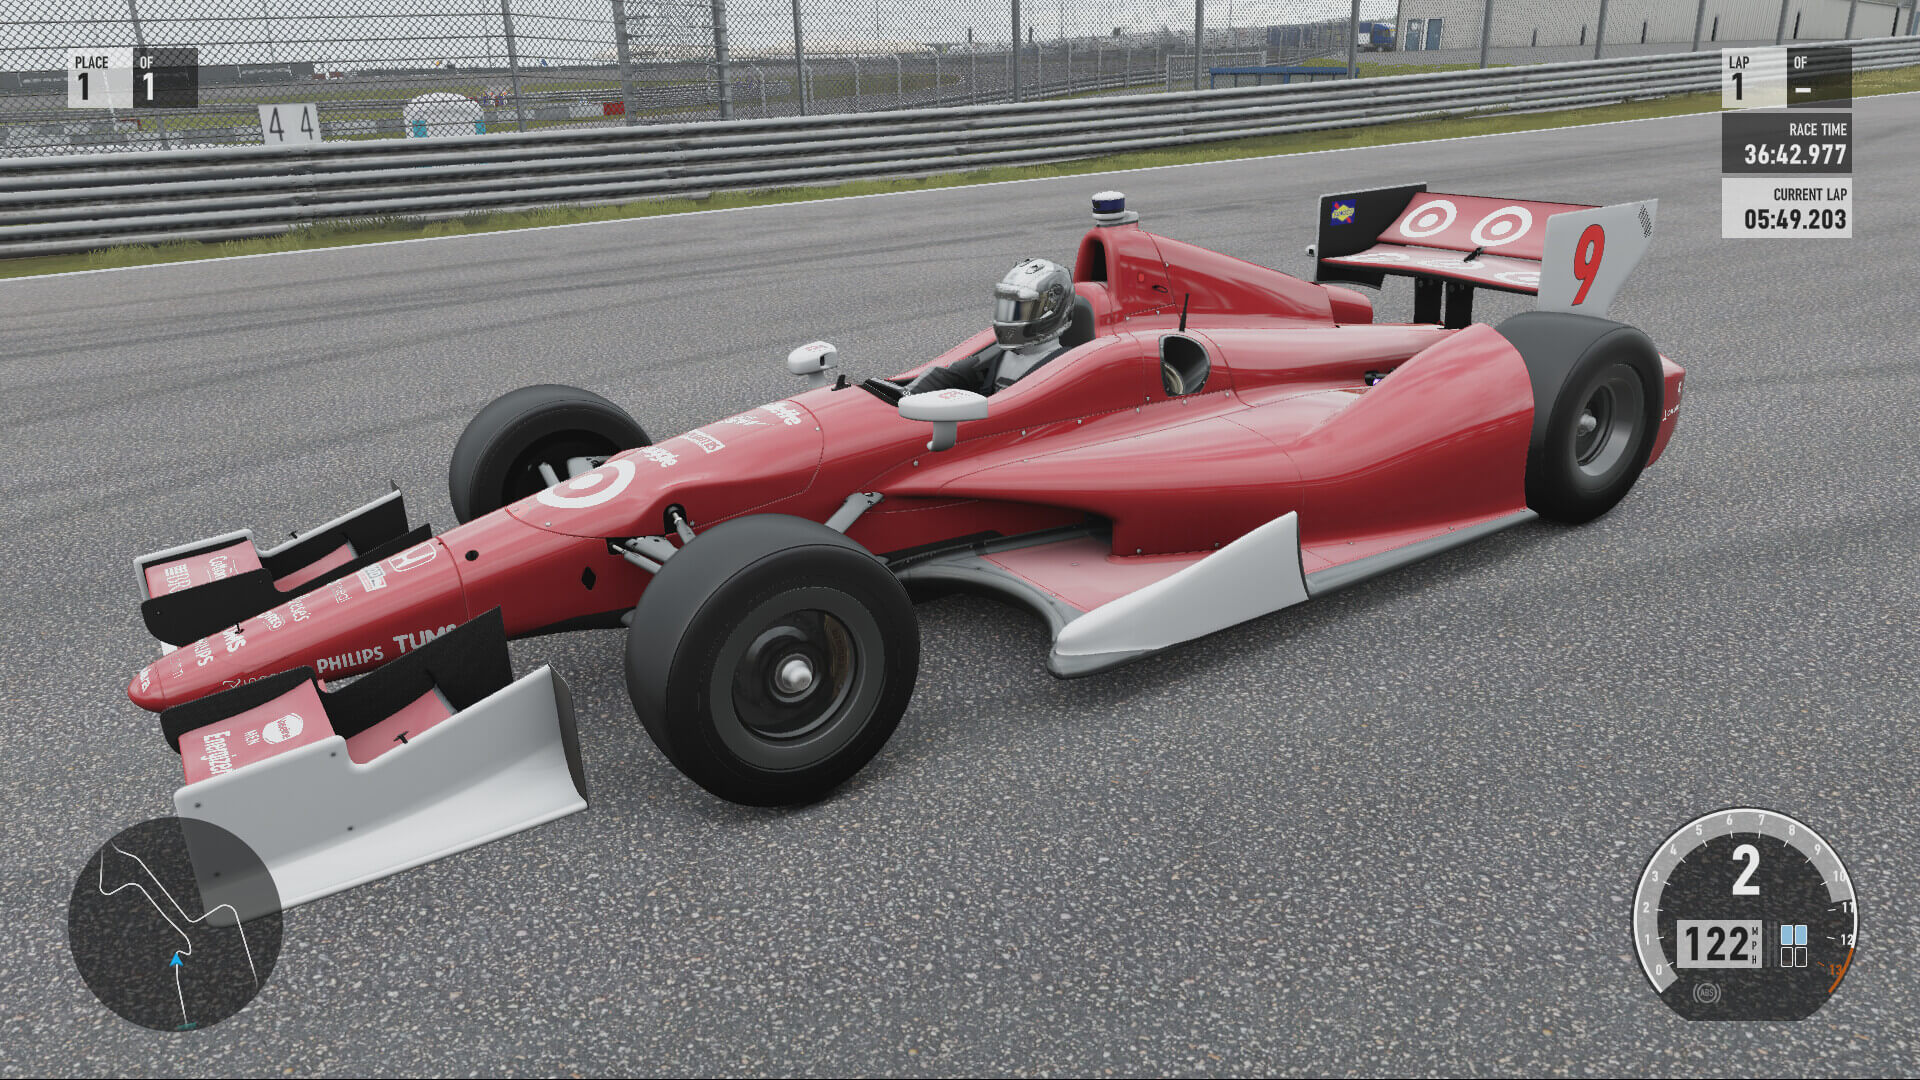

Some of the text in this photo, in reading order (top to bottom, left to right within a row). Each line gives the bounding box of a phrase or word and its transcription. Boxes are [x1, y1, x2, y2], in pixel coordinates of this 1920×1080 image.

[1571, 223, 1606, 307] 9
[316, 645, 385, 674] PHILIPS
[200, 730, 237, 775] Energizer
